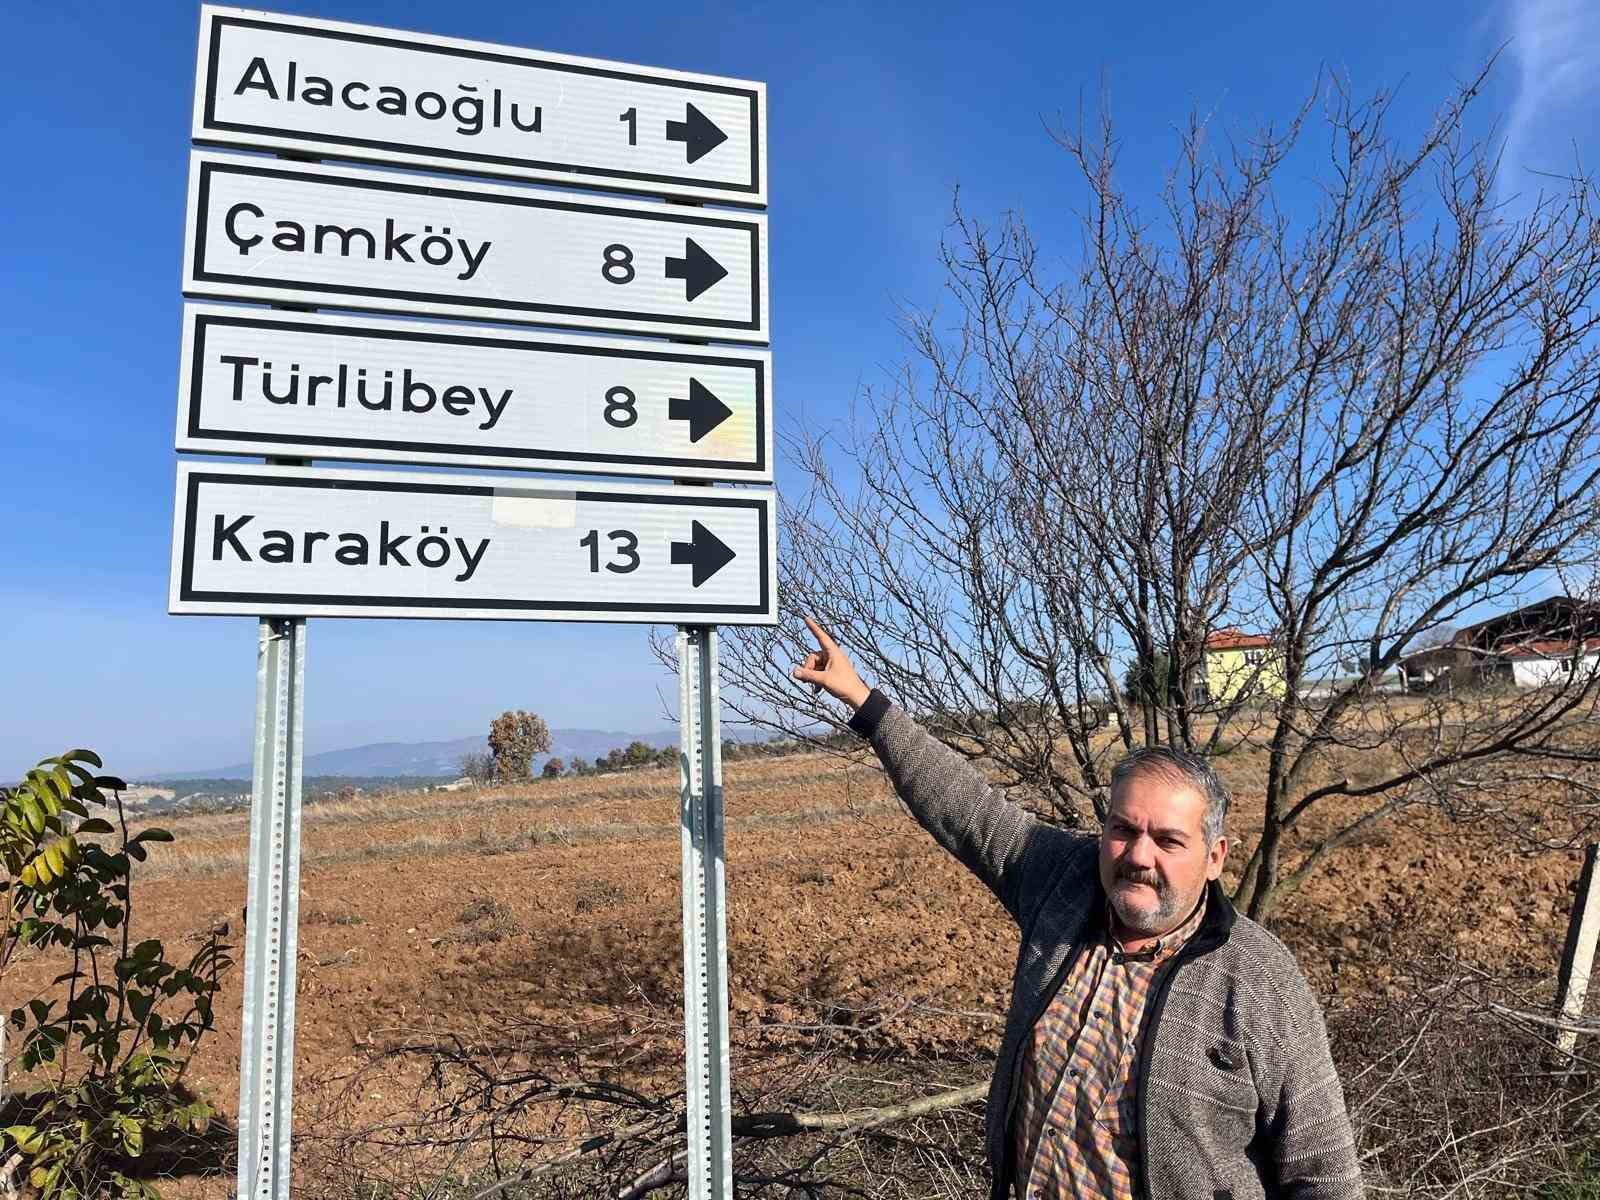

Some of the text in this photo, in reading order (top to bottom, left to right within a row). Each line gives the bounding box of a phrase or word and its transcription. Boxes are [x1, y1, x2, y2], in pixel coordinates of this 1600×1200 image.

[233, 56, 637, 146] Alacaoğlu 1
[224, 202, 636, 285] Çamköy 8
[220, 355, 638, 431] Türlübey 8
[212, 514, 641, 582] Karaköy 13
